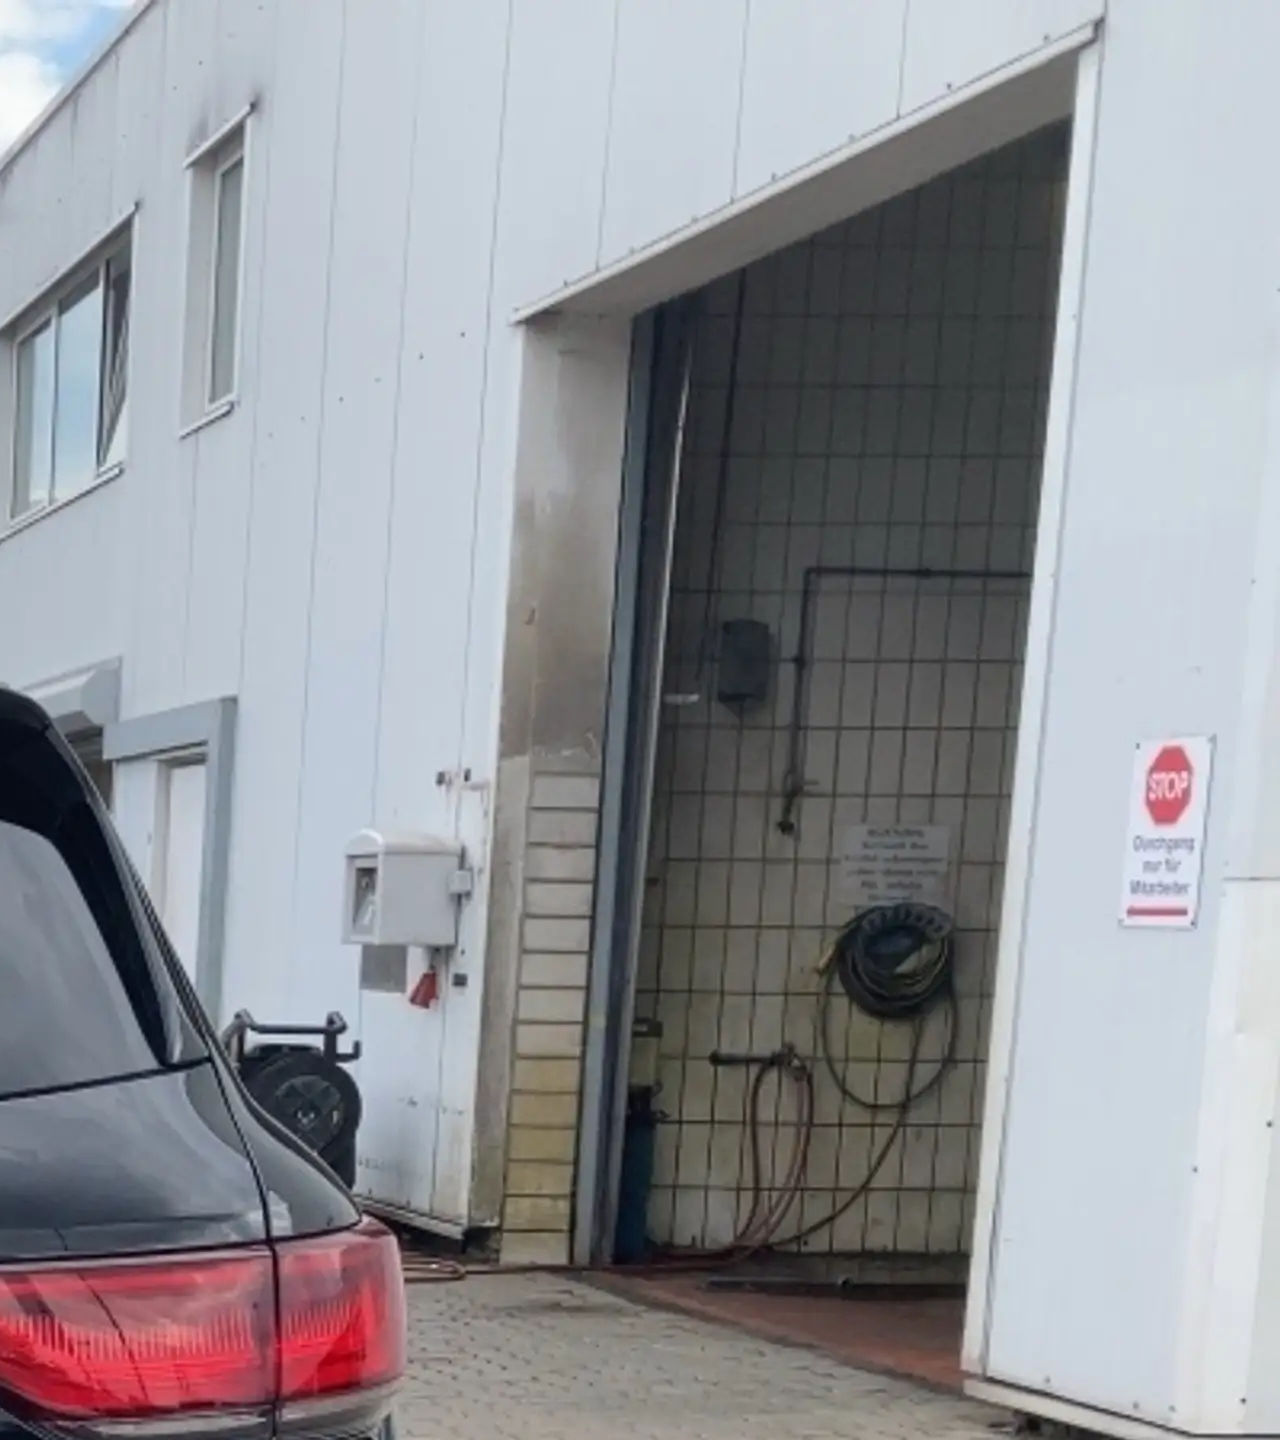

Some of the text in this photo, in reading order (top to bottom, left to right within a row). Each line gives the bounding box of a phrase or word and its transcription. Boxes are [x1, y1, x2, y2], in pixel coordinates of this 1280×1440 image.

[1148, 770, 1189, 801] STOP
[1133, 835, 1195, 854] Durchgang
[1142, 860, 1162, 873] nur
[1129, 879, 1191, 895] Mitarbeiter
